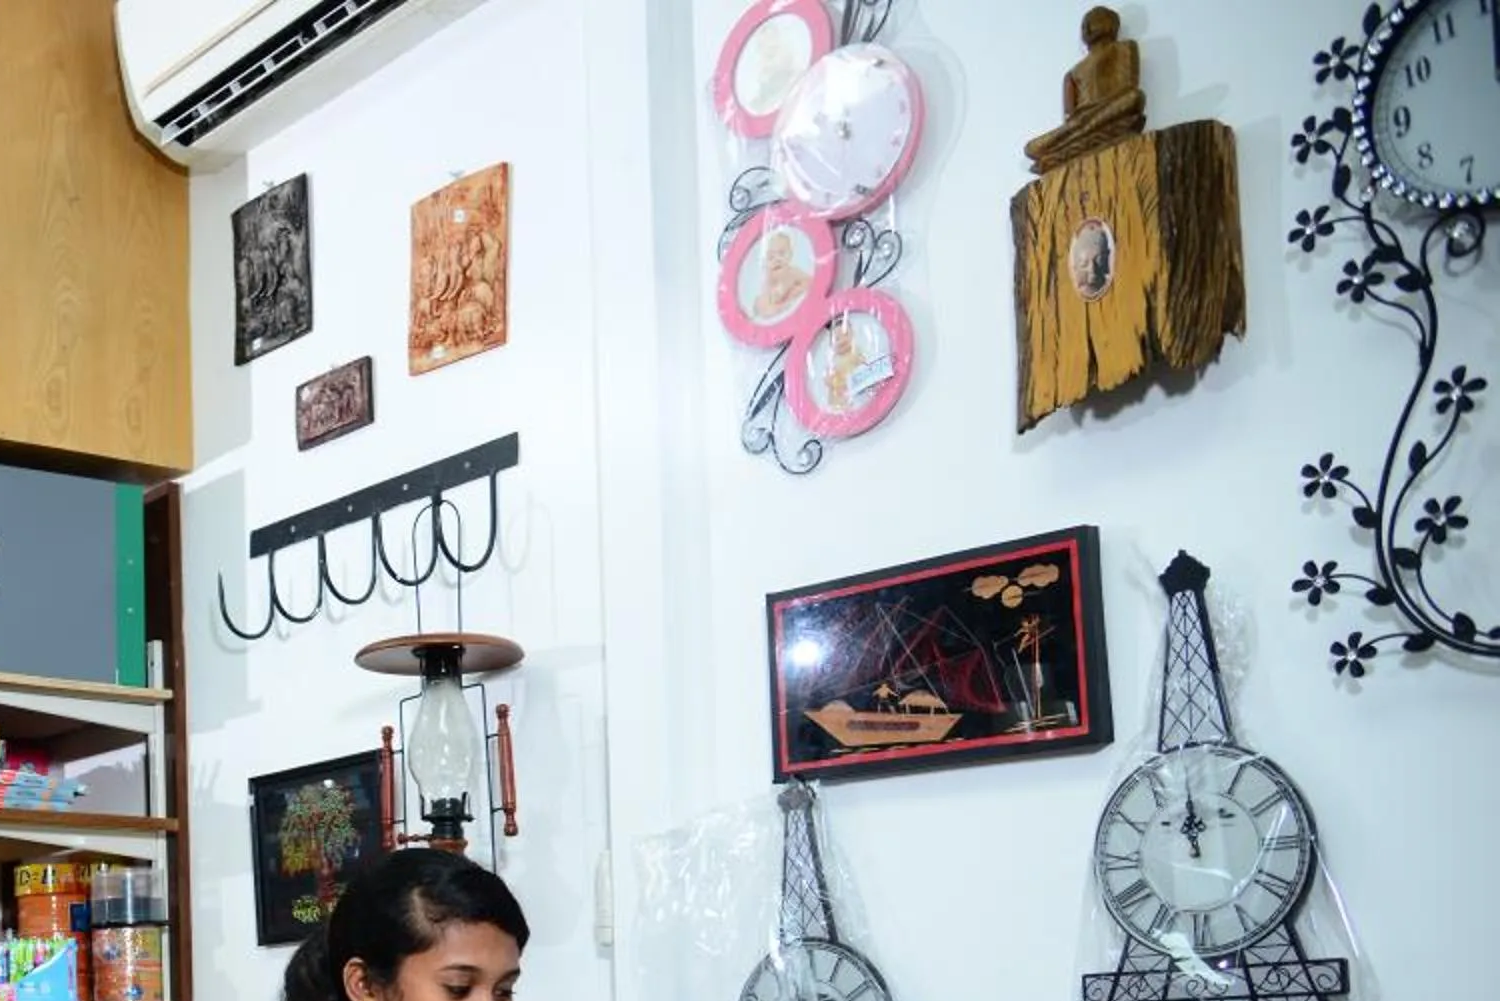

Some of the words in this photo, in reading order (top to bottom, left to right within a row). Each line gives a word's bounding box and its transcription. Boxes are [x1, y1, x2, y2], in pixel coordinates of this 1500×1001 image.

[1432, 12, 1455, 45] 11
[1404, 55, 1431, 88] 10
[1393, 106, 1411, 138] 9
[1417, 142, 1433, 169] 8
[1460, 155, 1474, 184] 7
